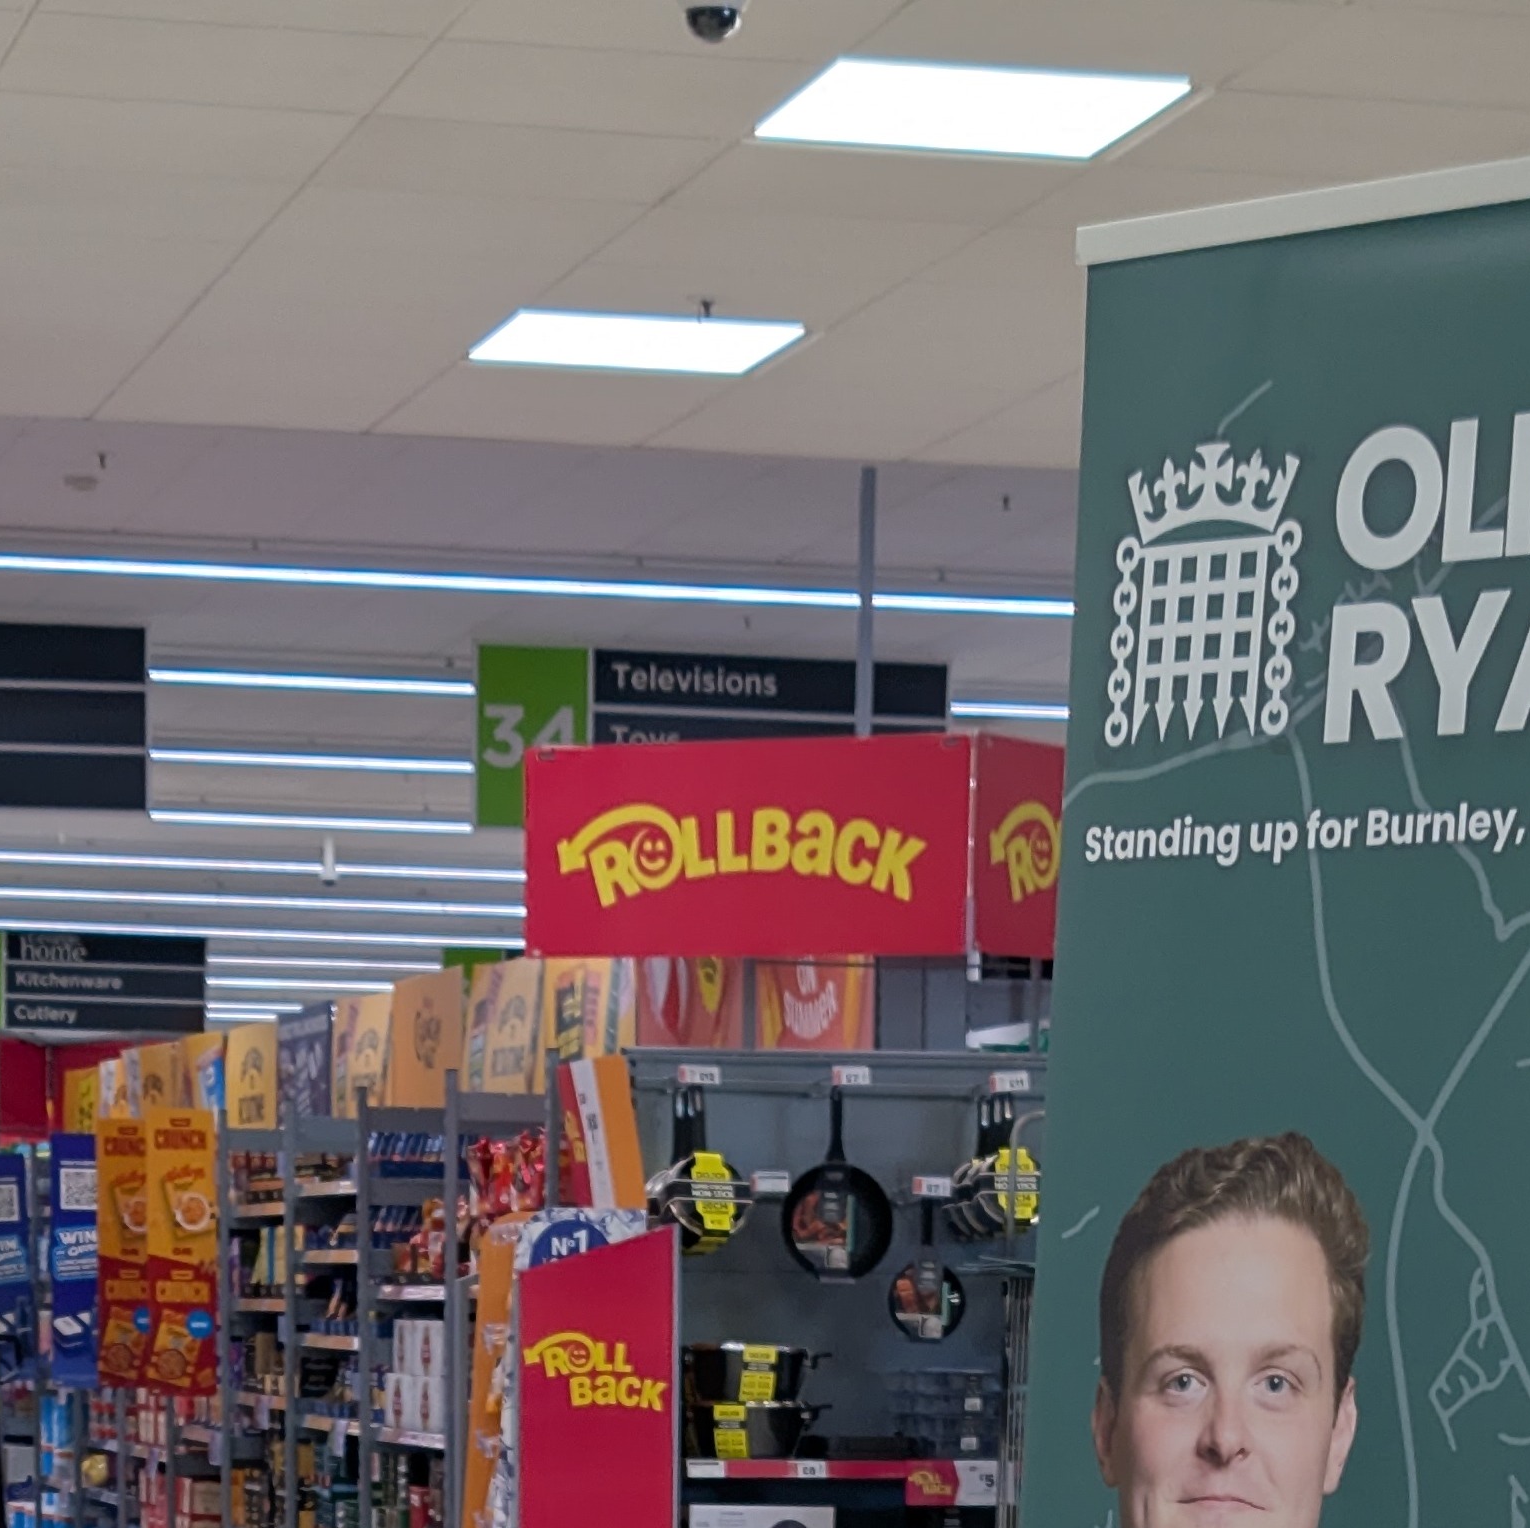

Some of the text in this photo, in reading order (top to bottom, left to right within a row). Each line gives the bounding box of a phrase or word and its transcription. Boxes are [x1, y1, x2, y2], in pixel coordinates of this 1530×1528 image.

[611, 661, 778, 698] Televisions
[1084, 815, 1241, 867] Standing
[1250, 822, 1299, 862] up
[1306, 808, 1359, 850] for
[1366, 802, 1527, 852] Burnley,
[15, 970, 124, 990] Kitchenware
[13, 1004, 78, 1024] Cutlery
[526, 1332, 633, 1376] ROLL
